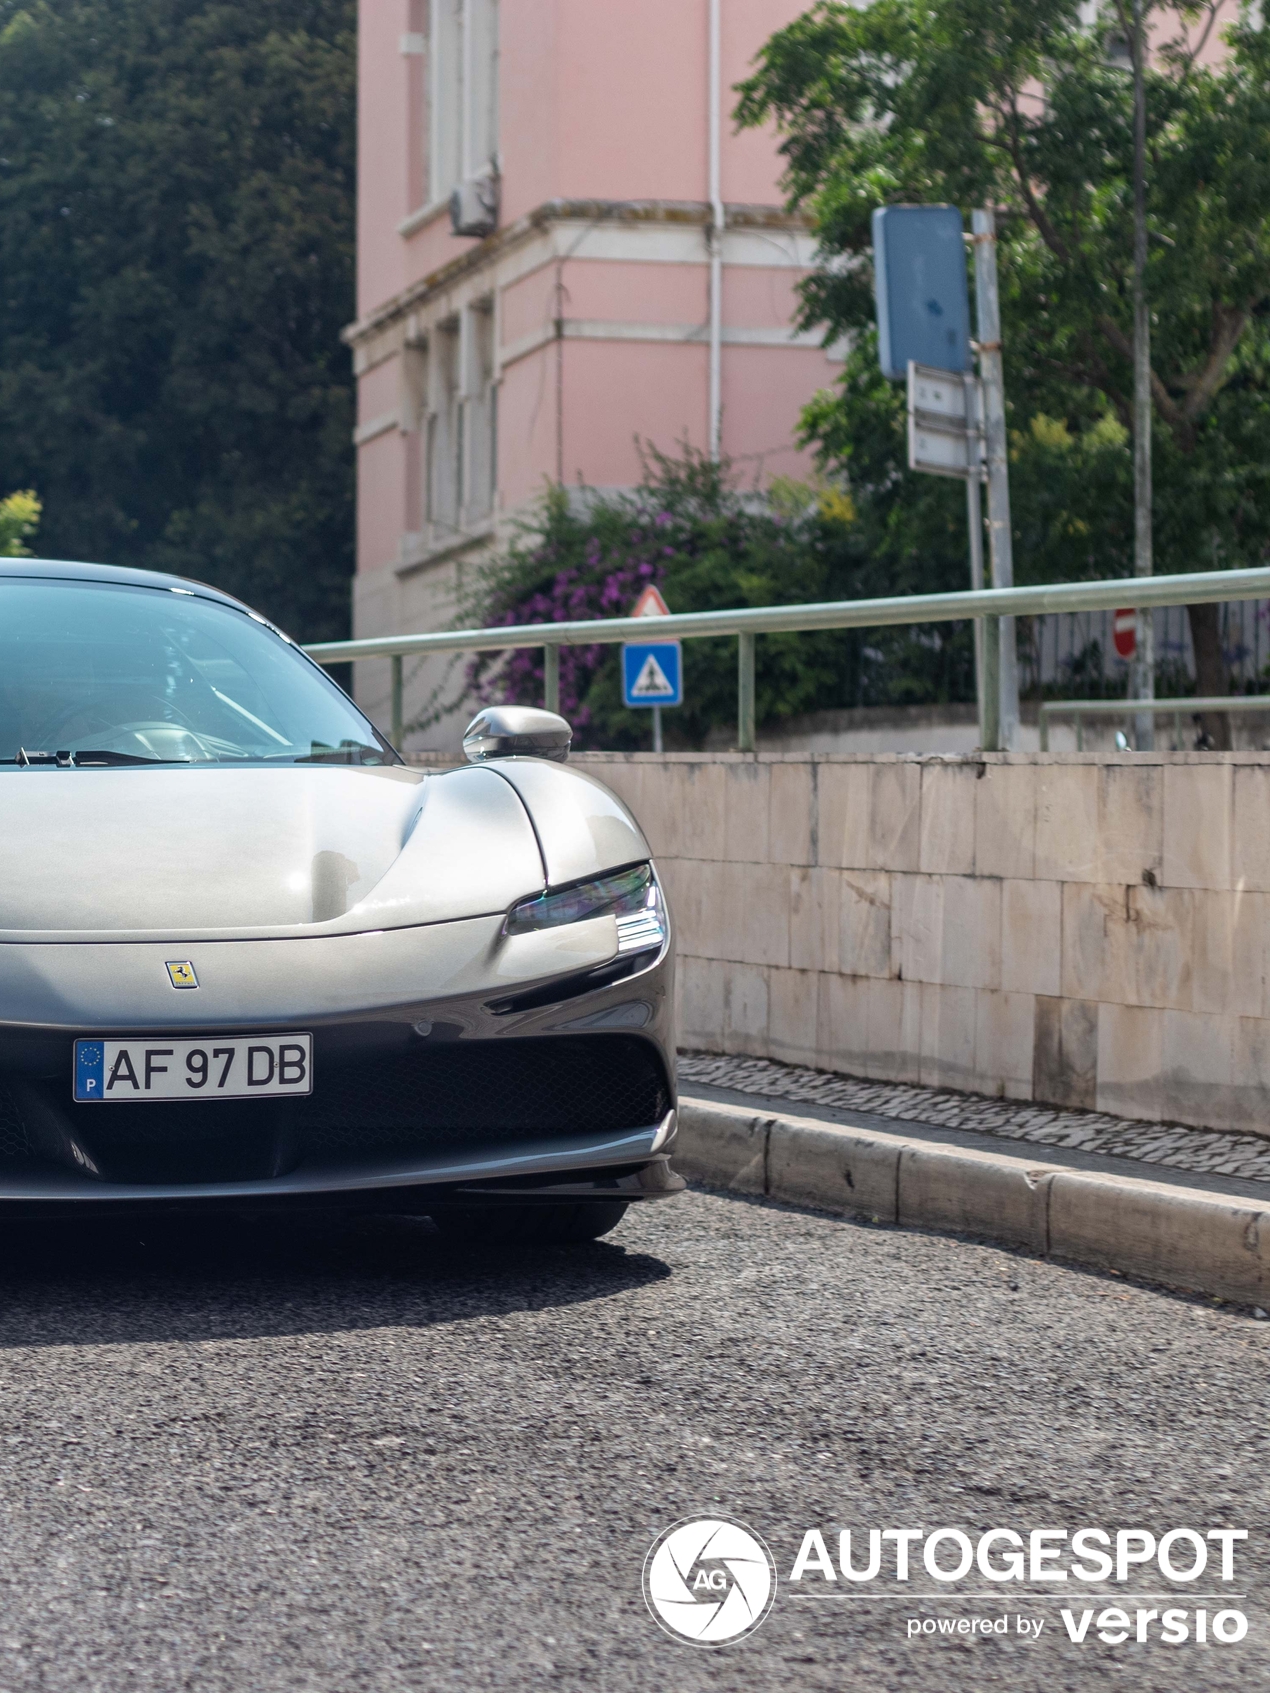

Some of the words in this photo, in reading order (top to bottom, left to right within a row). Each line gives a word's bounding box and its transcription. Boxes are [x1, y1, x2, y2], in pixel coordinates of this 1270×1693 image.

[106, 1049, 175, 1090] AF
[185, 1047, 235, 1088] 97
[247, 1044, 306, 1086] DB
[86, 1078, 96, 1092] P
